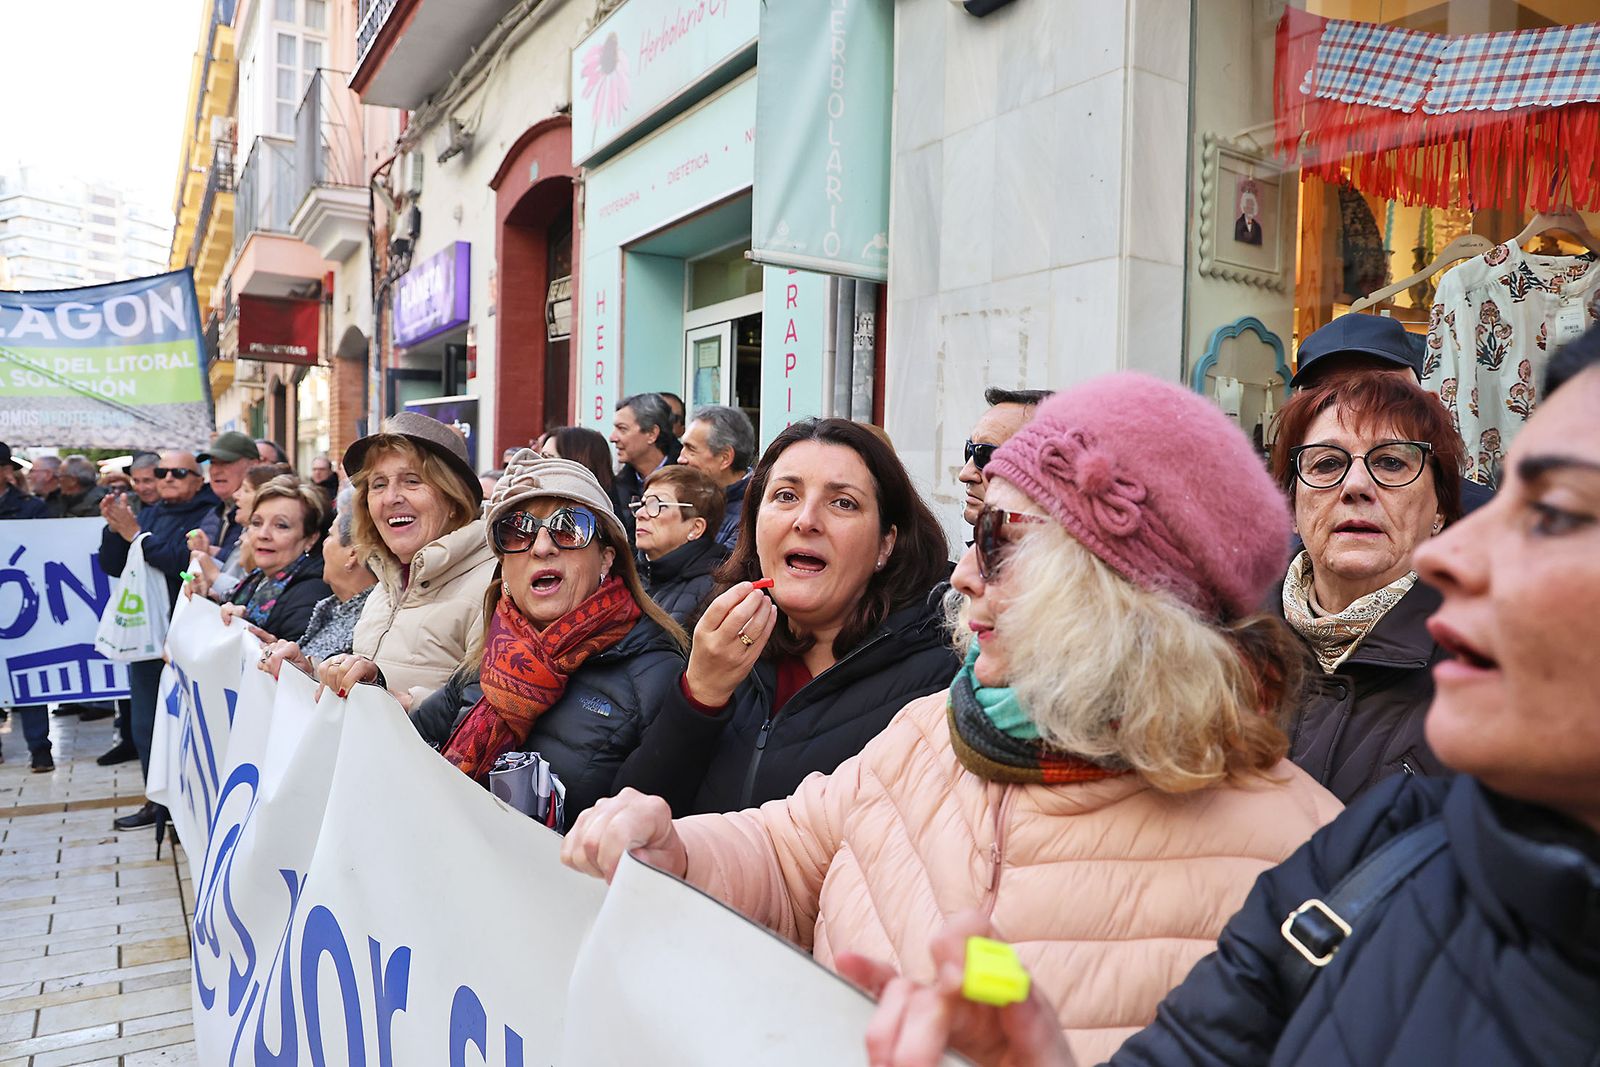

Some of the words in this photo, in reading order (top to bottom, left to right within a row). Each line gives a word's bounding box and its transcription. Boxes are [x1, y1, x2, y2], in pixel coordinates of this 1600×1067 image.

[667, 153, 710, 185] DIETÉTICA
[0, 286, 187, 341] AGON
[54, 356, 99, 374] DEL
[106, 351, 194, 374] LITORAL
[784, 268, 799, 428] RAPI
